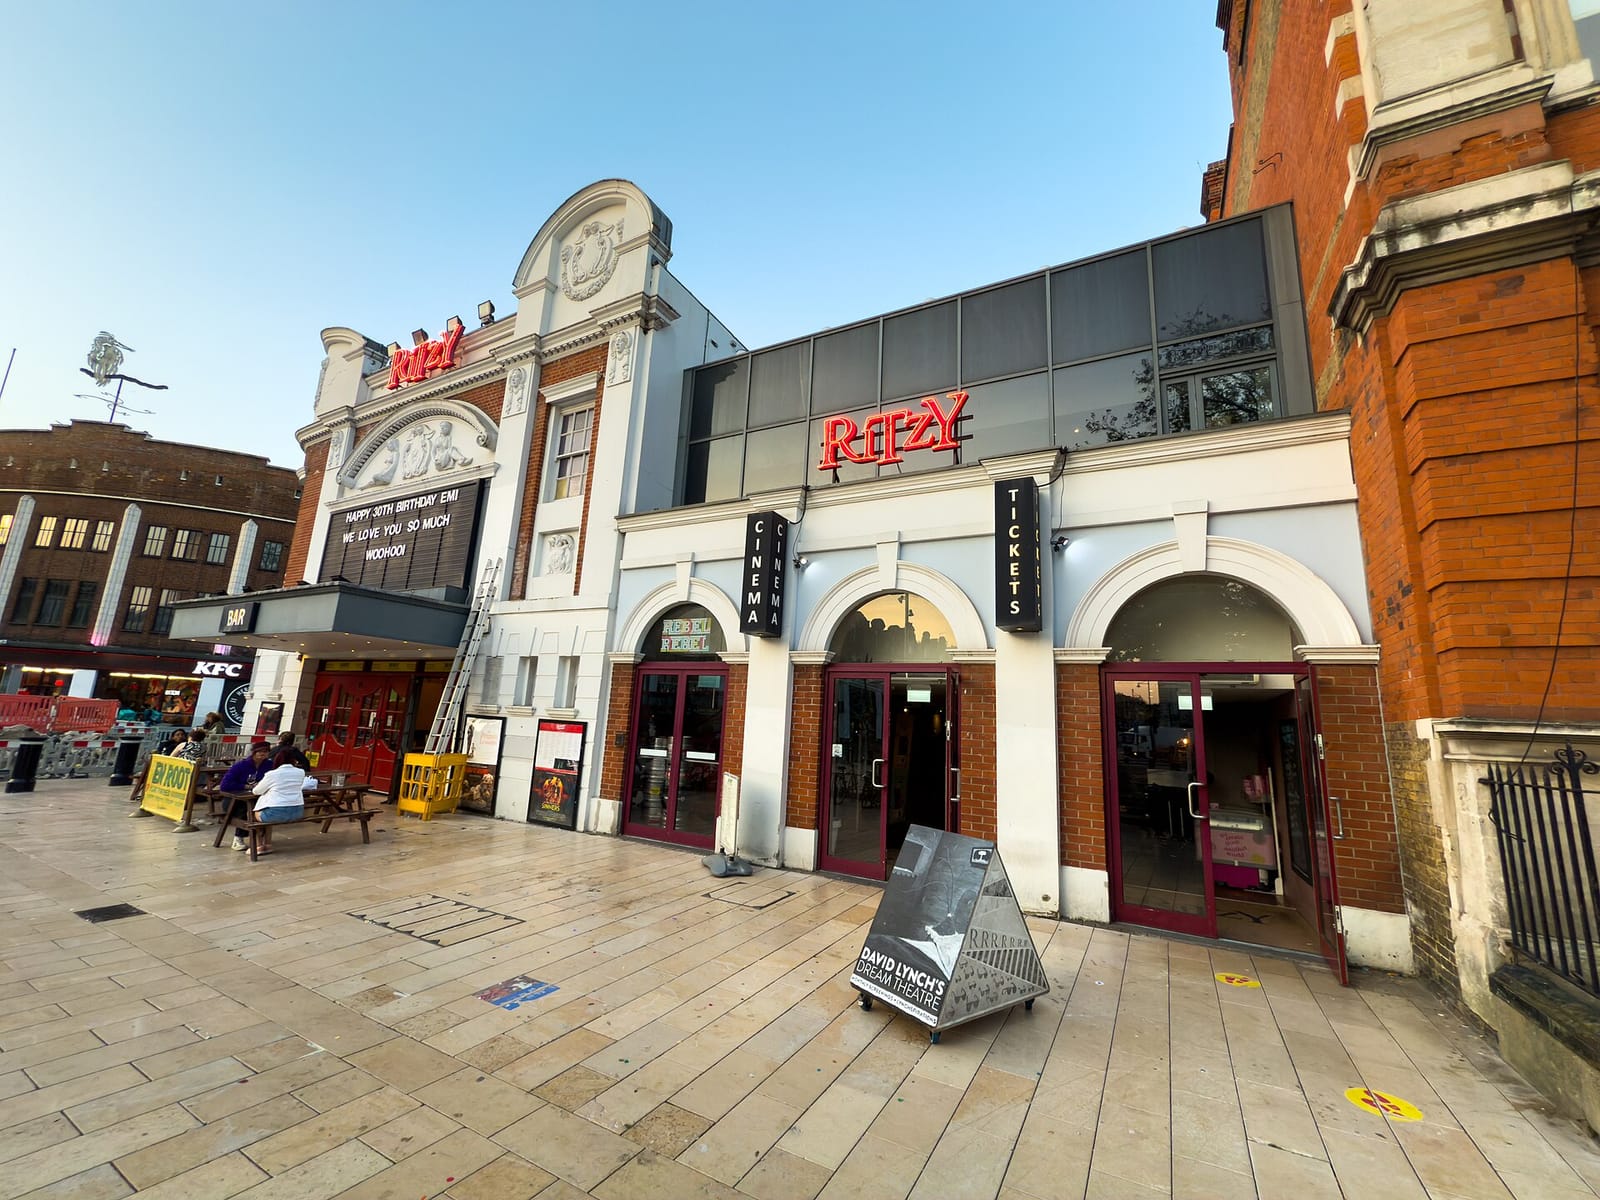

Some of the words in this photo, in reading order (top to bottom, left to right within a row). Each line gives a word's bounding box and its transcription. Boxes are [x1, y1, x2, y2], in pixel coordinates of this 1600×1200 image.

[346, 508, 371, 523] HAPPY
[372, 503, 395, 518] 30TH
[395, 493, 438, 513] BIRTHDAY
[440, 489, 460, 504] EMI
[342, 532, 354, 544] WE
[358, 527, 380, 541] LOVE
[384, 522, 402, 537] YOU
[407, 519, 420, 533] SO
[422, 513, 451, 530] MUCH
[1008, 488, 1021, 615] TICKETS
[747, 520, 764, 624] CINEMA
[771, 523, 784, 626] CINEMA
[226, 608, 246, 627] BAR
[660, 635, 710, 653] REBEL
[192, 661, 243, 677] KFC
[164, 764, 191, 791] ROOT
[856, 959, 892, 987] DREAM
[893, 976, 941, 1012] THEATRE
[860, 946, 896, 972] DAVID
[895, 962, 946, 996] LYNCH'S
